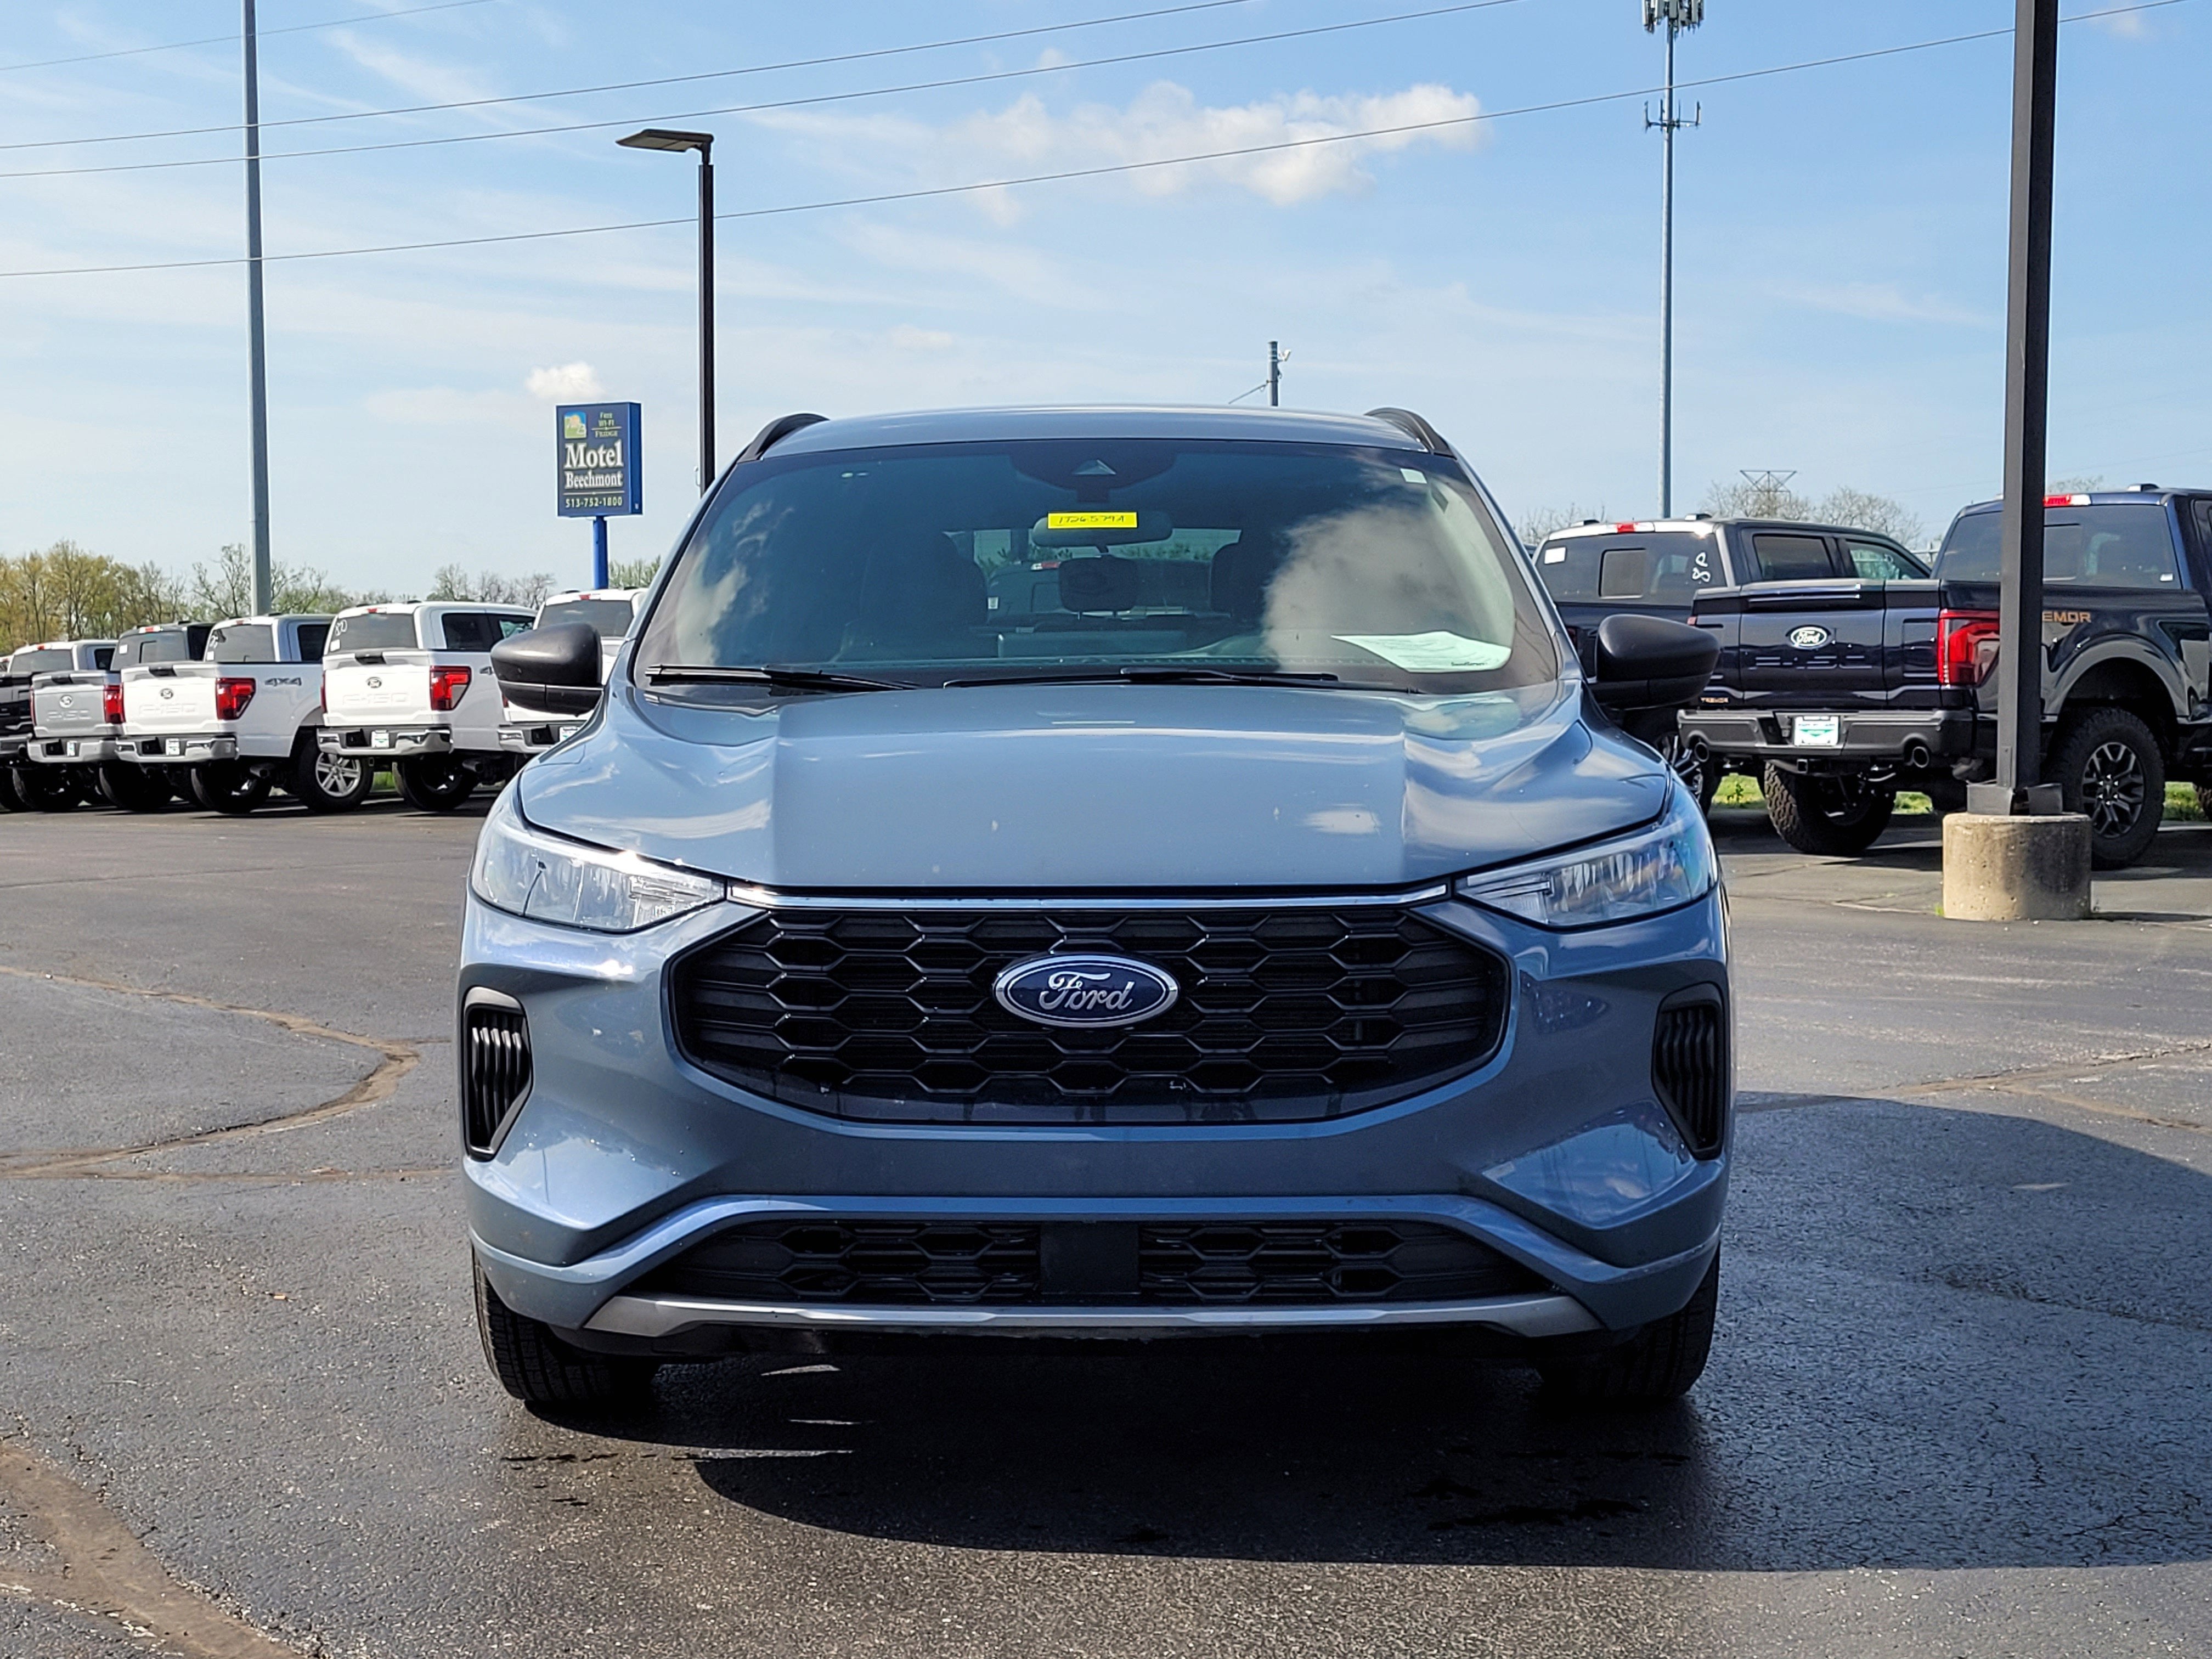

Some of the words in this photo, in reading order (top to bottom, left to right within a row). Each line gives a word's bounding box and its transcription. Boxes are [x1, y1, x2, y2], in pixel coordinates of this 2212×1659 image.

[564, 438, 624, 469] Motel
[565, 470, 624, 489] Beechmont
[565, 496, 623, 508] 513-752-1800
[2042, 611, 2091, 623] EMOR
[1797, 630, 1821, 644] Ford
[1039, 970, 1135, 1010] Ford
